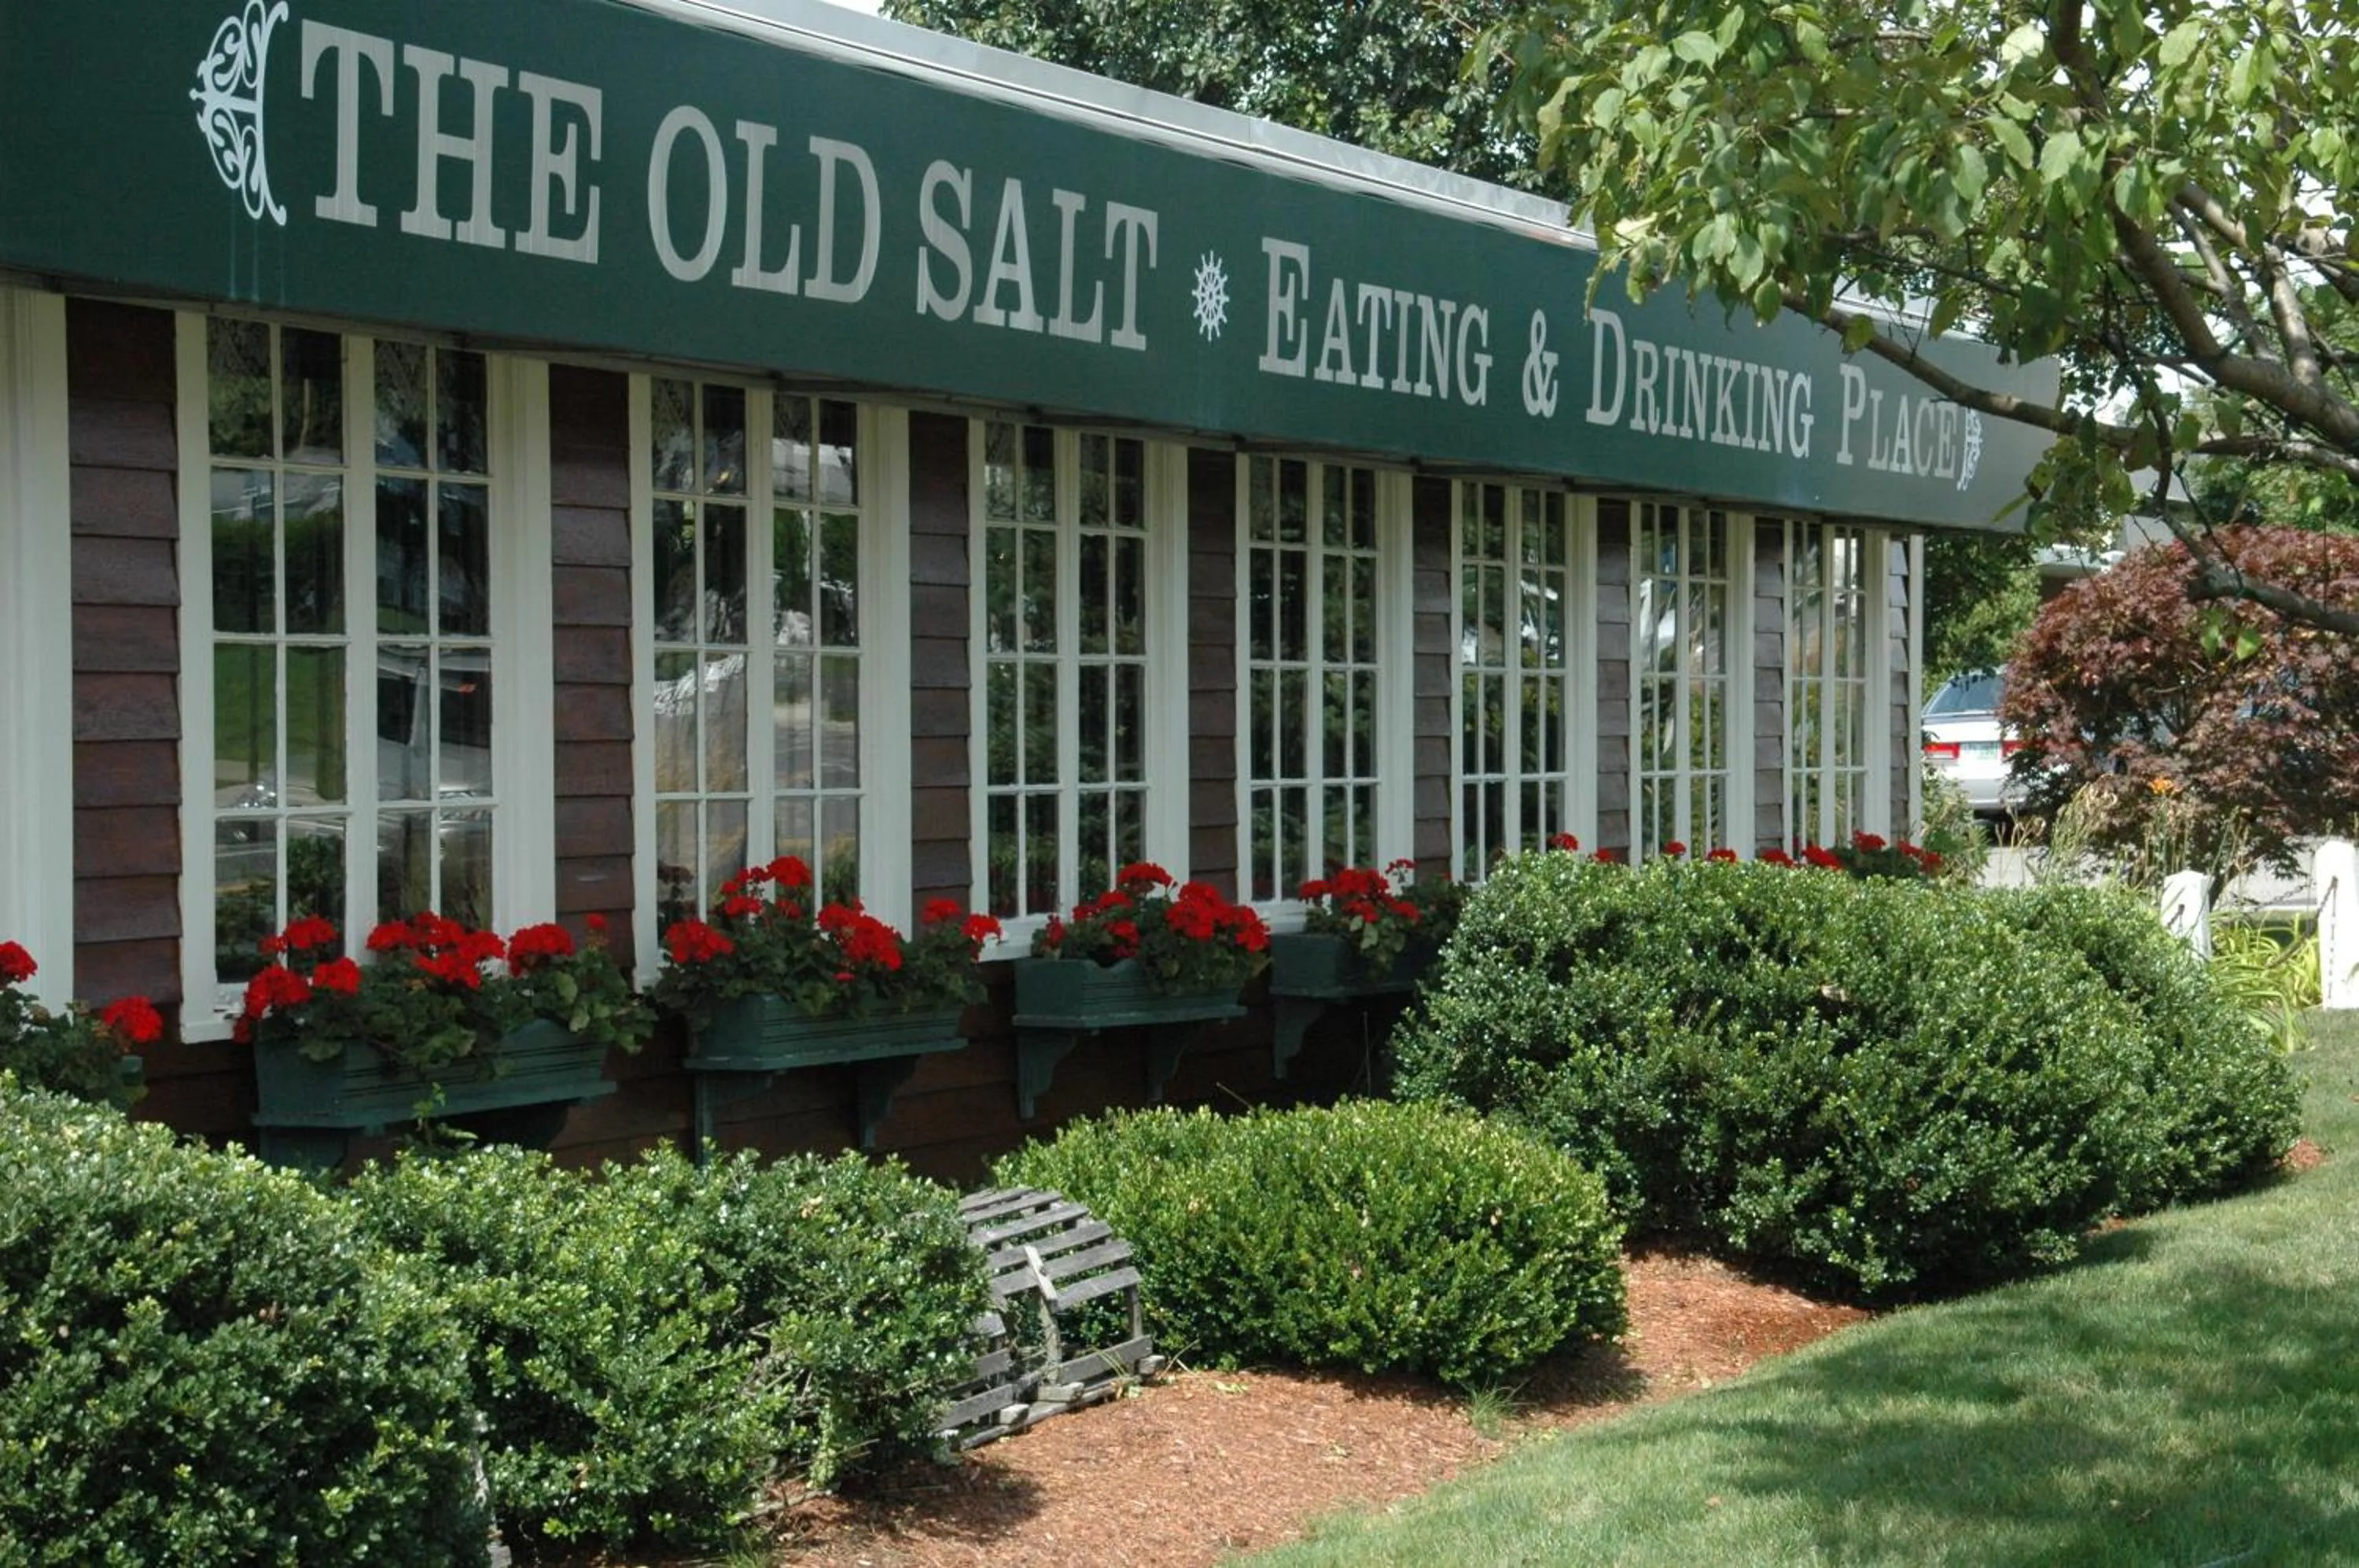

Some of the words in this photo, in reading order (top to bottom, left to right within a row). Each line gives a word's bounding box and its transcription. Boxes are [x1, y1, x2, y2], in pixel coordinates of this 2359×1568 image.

[300, 19, 603, 265] THE
[647, 105, 881, 304] OLD
[916, 160, 1159, 352] SALT
[1258, 237, 1492, 407] EATING
[1522, 309, 1559, 418] &
[1585, 307, 1814, 459] DRINKING
[1836, 362, 1958, 479] PLACE
